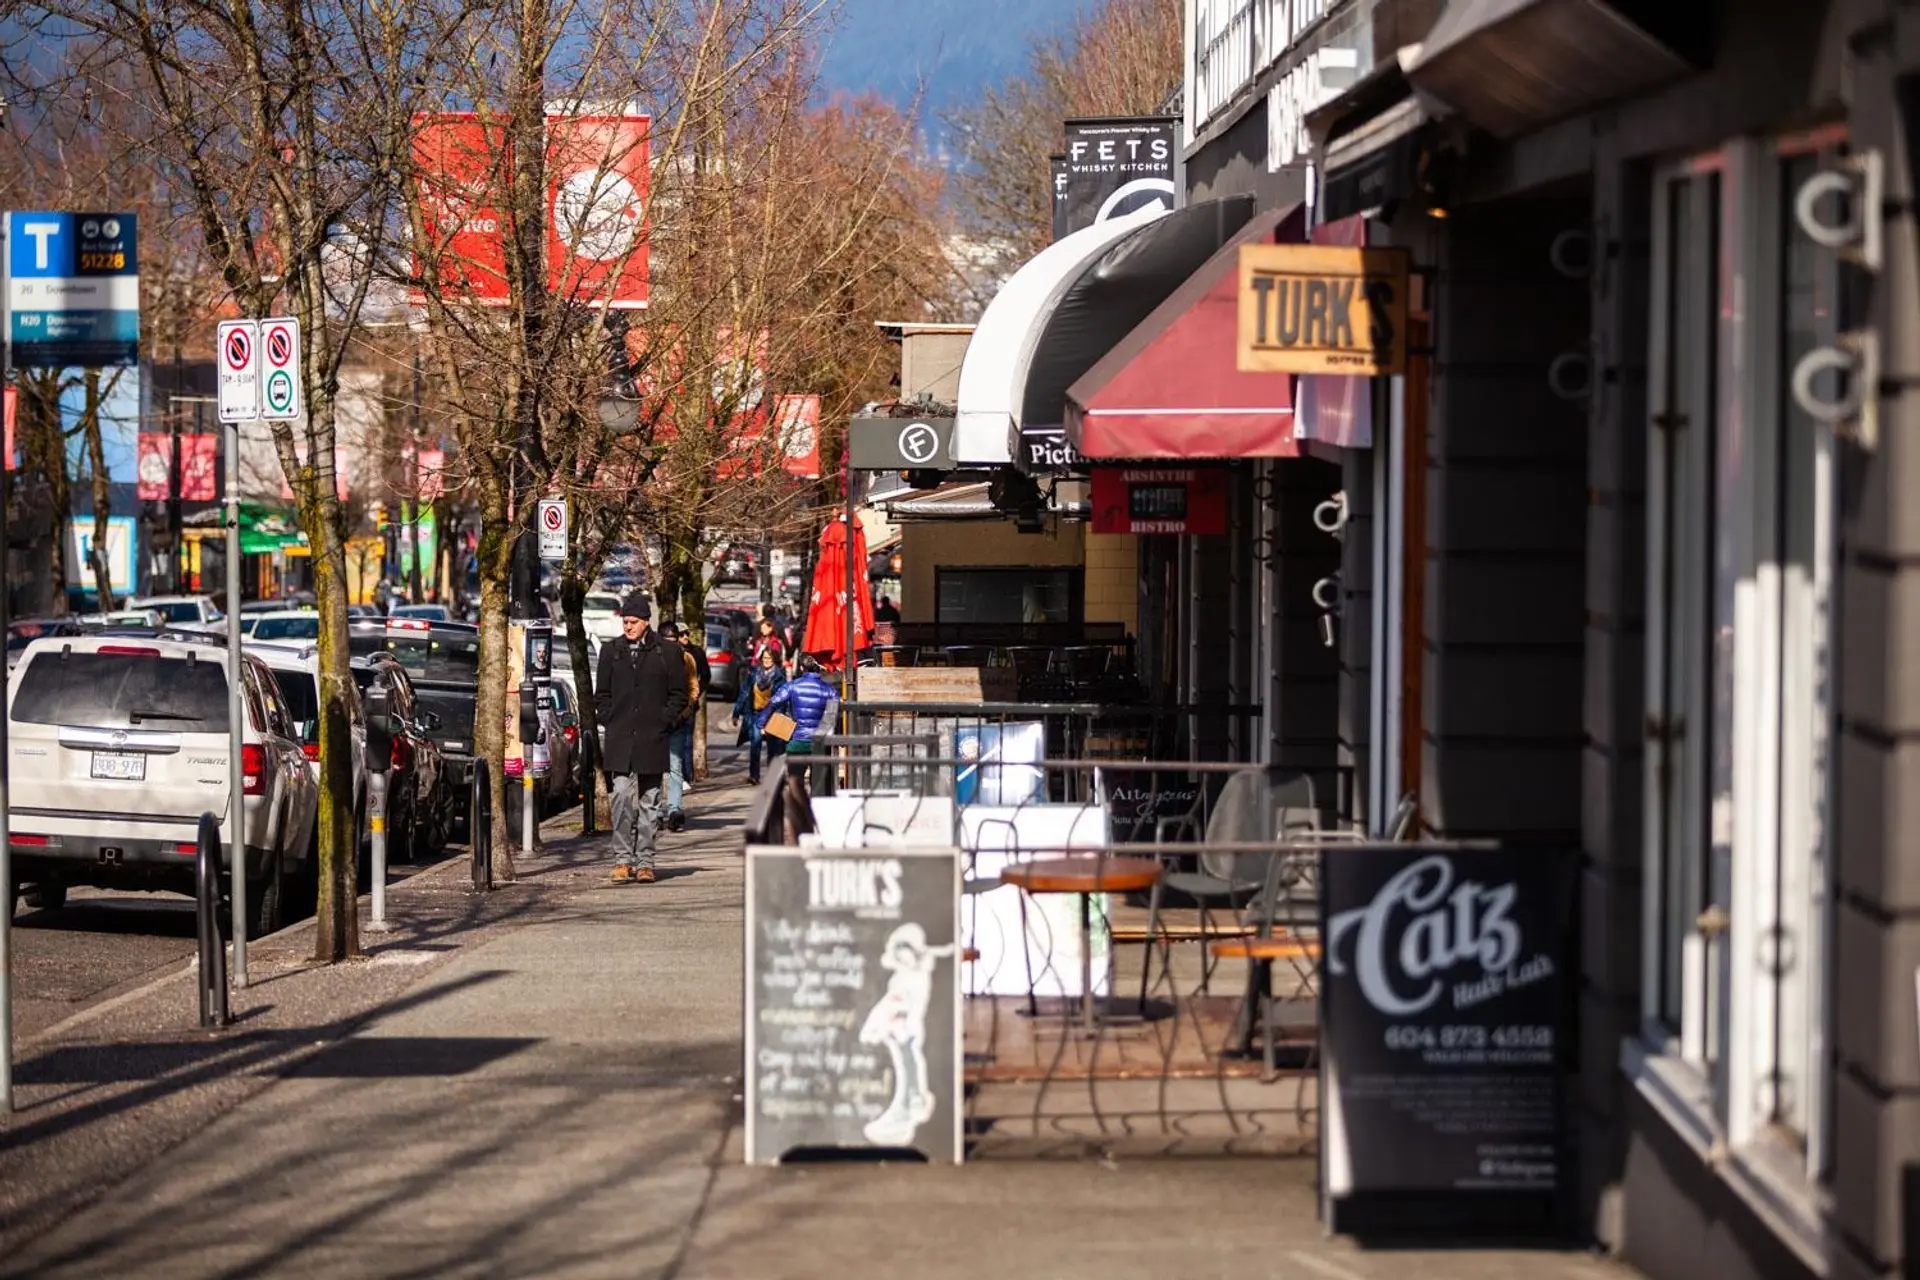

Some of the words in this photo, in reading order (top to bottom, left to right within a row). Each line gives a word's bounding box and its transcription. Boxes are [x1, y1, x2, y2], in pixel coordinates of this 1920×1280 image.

[1070, 139, 1169, 161] FETS
[1072, 164, 1116, 173] WHISKY
[1120, 163, 1168, 172] KITCHEN
[24, 222, 60, 270] T
[81, 252, 125, 269] 51228
[1252, 277, 1394, 347] TURK'S
[1120, 469, 1195, 482] ABSINTHE
[1130, 520, 1187, 533] BISTRO
[805, 858, 903, 908] TURK'S
[1327, 855, 1522, 1015] Catz
[1384, 1025, 1436, 1049] 604
